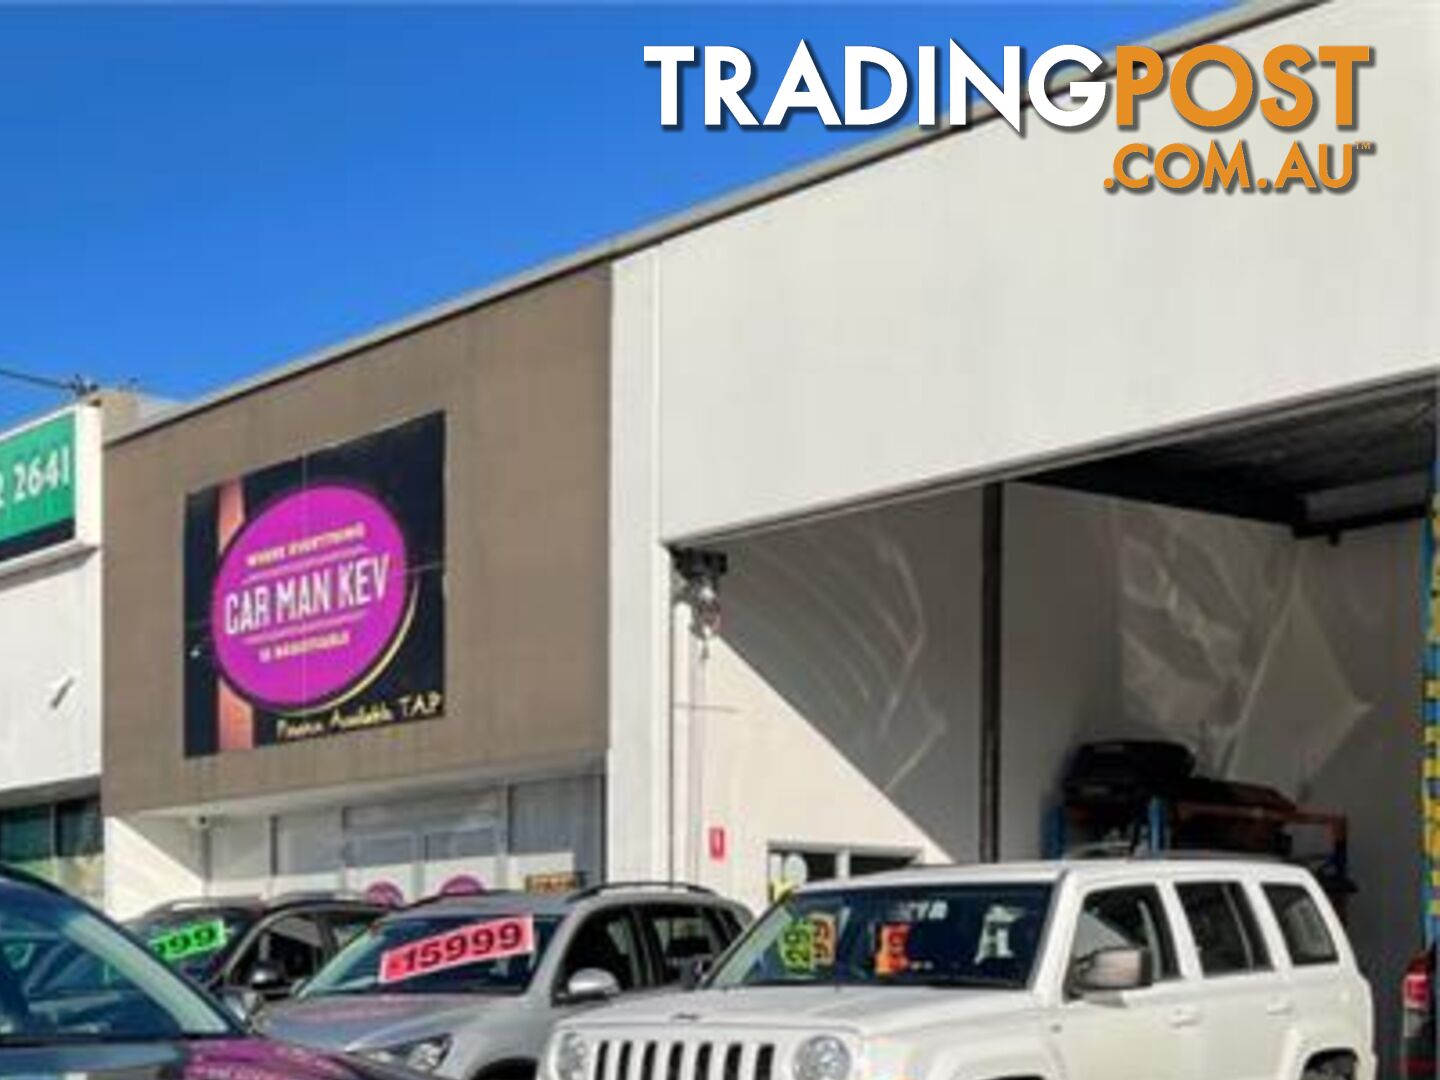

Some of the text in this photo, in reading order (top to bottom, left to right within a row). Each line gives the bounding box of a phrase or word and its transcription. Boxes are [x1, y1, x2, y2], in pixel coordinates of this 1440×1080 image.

[13, 446, 72, 502] 2641
[225, 553, 391, 635] CAR MAN KEV
